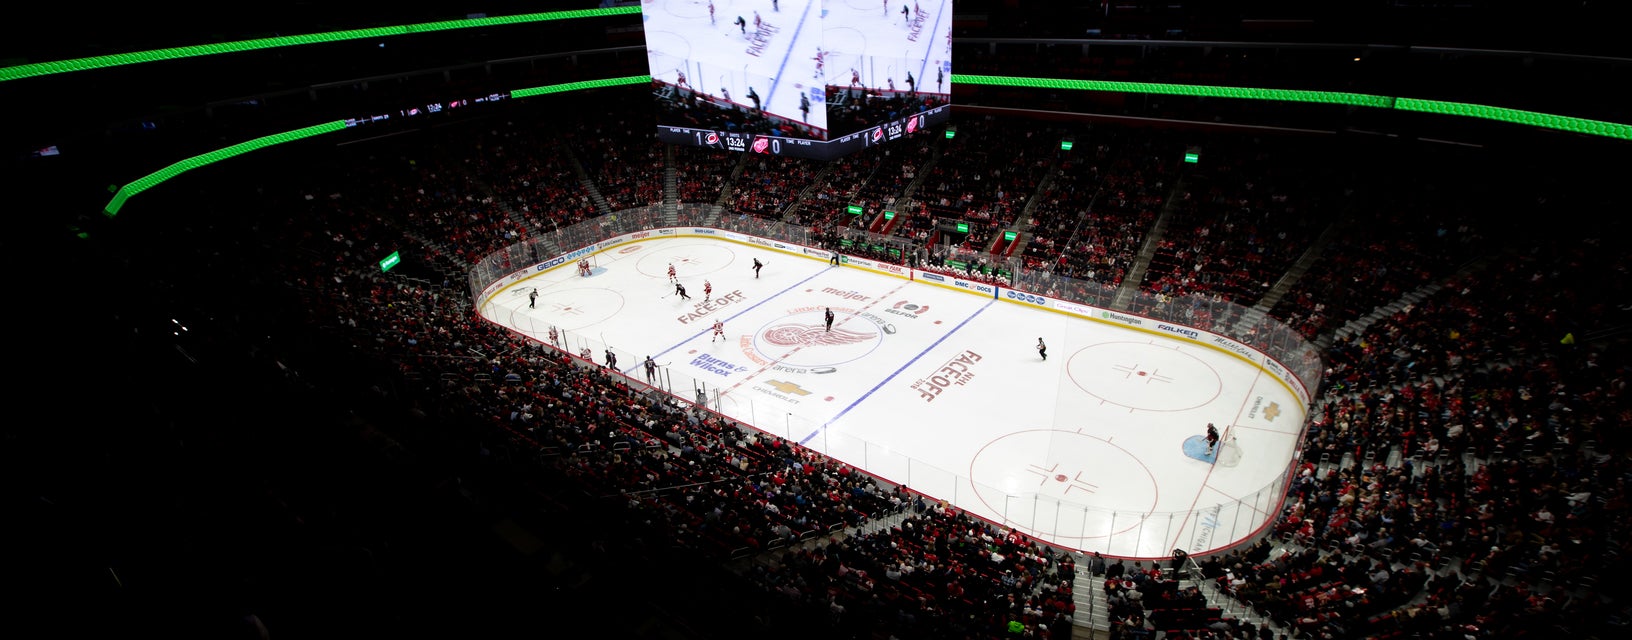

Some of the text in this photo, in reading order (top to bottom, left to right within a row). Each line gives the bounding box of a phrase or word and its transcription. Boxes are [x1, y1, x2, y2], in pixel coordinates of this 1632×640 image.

[920, 115, 925, 128] 0
[696, 131, 702, 146] 1
[726, 137, 745, 148] 13:24
[864, 132, 869, 147] 1
[772, 139, 780, 154] 0
[536, 256, 565, 271] GEICO
[821, 286, 872, 302] meijer
[954, 280, 992, 293] DMC DOCS
[677, 289, 743, 325] FACE-OFF
[884, 308, 918, 319] BELFOR
[1109, 312, 1142, 326] Huntington
[1157, 323, 1199, 338] FALKEN
[689, 358, 732, 377] Wilcox
[697, 353, 735, 370] Burns
[772, 364, 807, 375] arena
[917, 350, 982, 403] FACE-OFF
[953, 372, 976, 386] NHL
[752, 385, 800, 405] CHEVROLET
